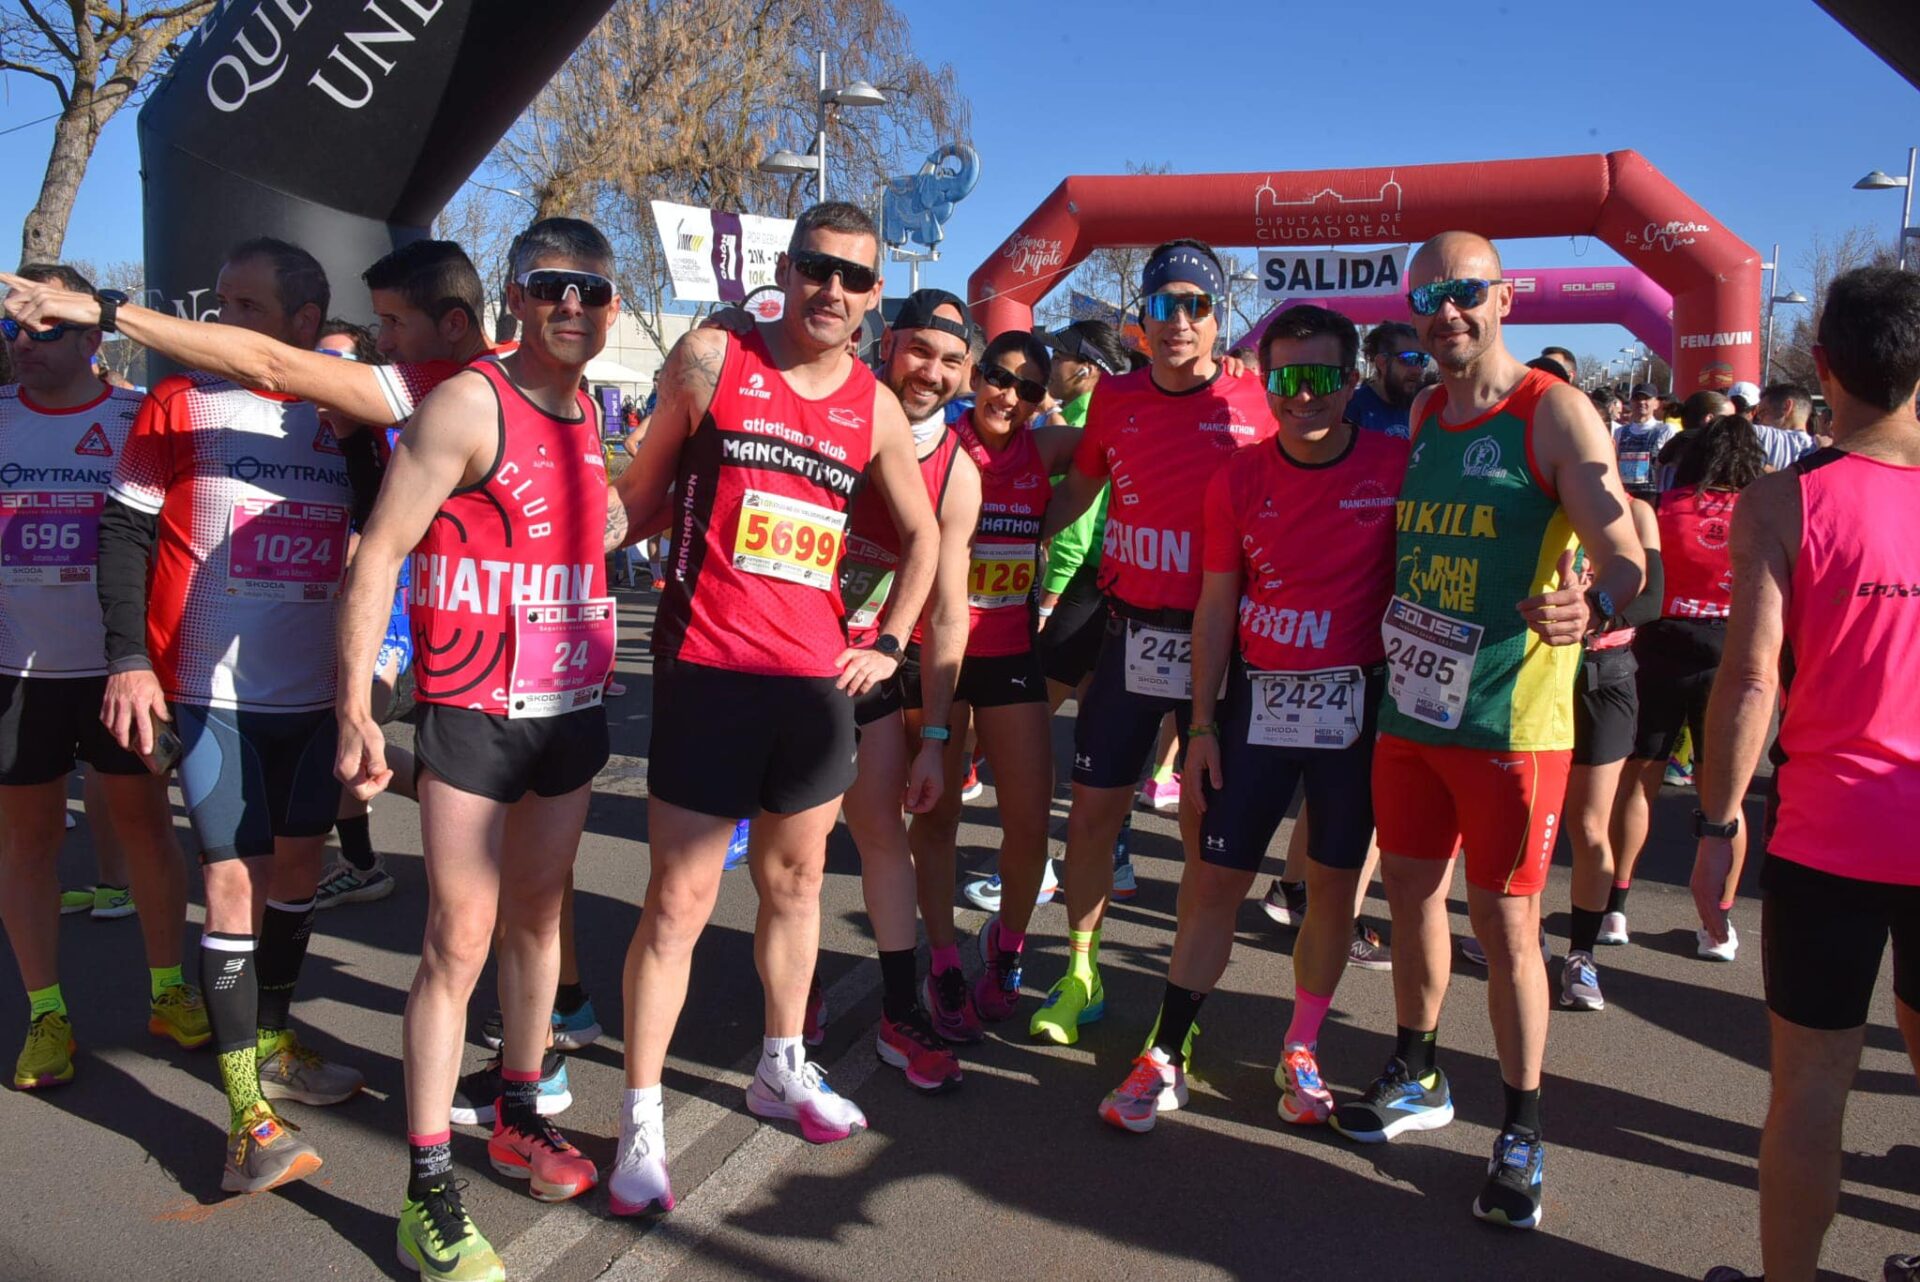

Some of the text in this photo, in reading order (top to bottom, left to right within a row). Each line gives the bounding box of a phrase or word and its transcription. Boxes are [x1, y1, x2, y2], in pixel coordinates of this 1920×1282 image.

[1380, 212, 1401, 222] DE
[1256, 224, 1401, 240] CIUDAD REAL
[1011, 246, 1063, 276] Quijote
[1264, 253, 1399, 292] SALIDA
[1562, 282, 1616, 292] SOLISS
[1680, 331, 1753, 349] FENAVIN
[743, 418, 816, 447] atletismo
[818, 440, 847, 461] club
[722, 437, 856, 495] MANCHATHON
[1106, 447, 1139, 505] CLUB
[1, 494, 95, 508] SOLISS
[243, 499, 344, 523] SOLISS
[496, 461, 551, 539] CLUB
[1010, 502, 1031, 514] club
[21, 523, 81, 550] 696
[674, 474, 698, 582] MANCHATHON
[978, 517, 1040, 534] HATHON
[253, 533, 332, 566] 1024
[744, 514, 835, 567] 5699
[973, 562, 1031, 593] 126
[1431, 554, 1479, 580] RUN
[526, 605, 609, 624] SOLISS
[1439, 588, 1476, 613] ME
[1393, 602, 1470, 644] SOLISS
[551, 640, 589, 673] 24
[1387, 637, 1458, 686] 2485
[526, 694, 562, 702] SKODA
[1267, 682, 1348, 710] 2424
